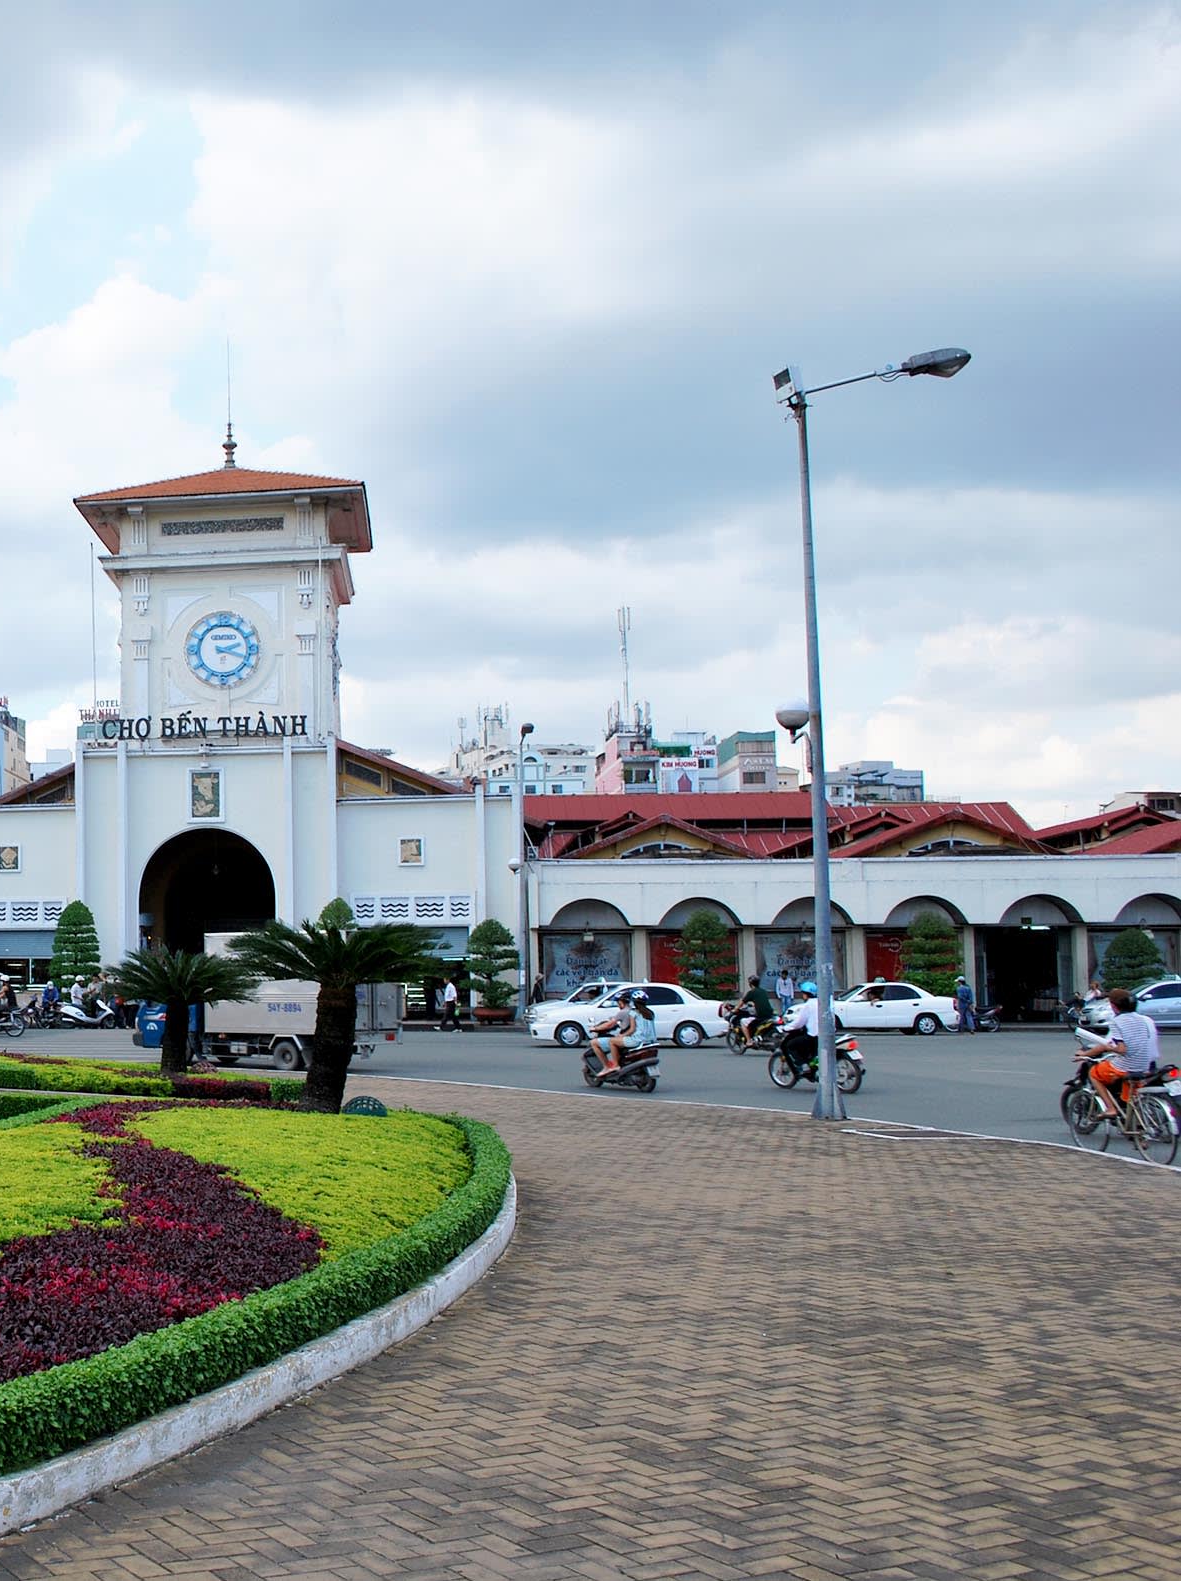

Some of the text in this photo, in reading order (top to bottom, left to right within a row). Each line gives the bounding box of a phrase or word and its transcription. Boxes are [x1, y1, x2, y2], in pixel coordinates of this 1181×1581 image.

[102, 710, 308, 742] CHỢ BẾN THÀNH
